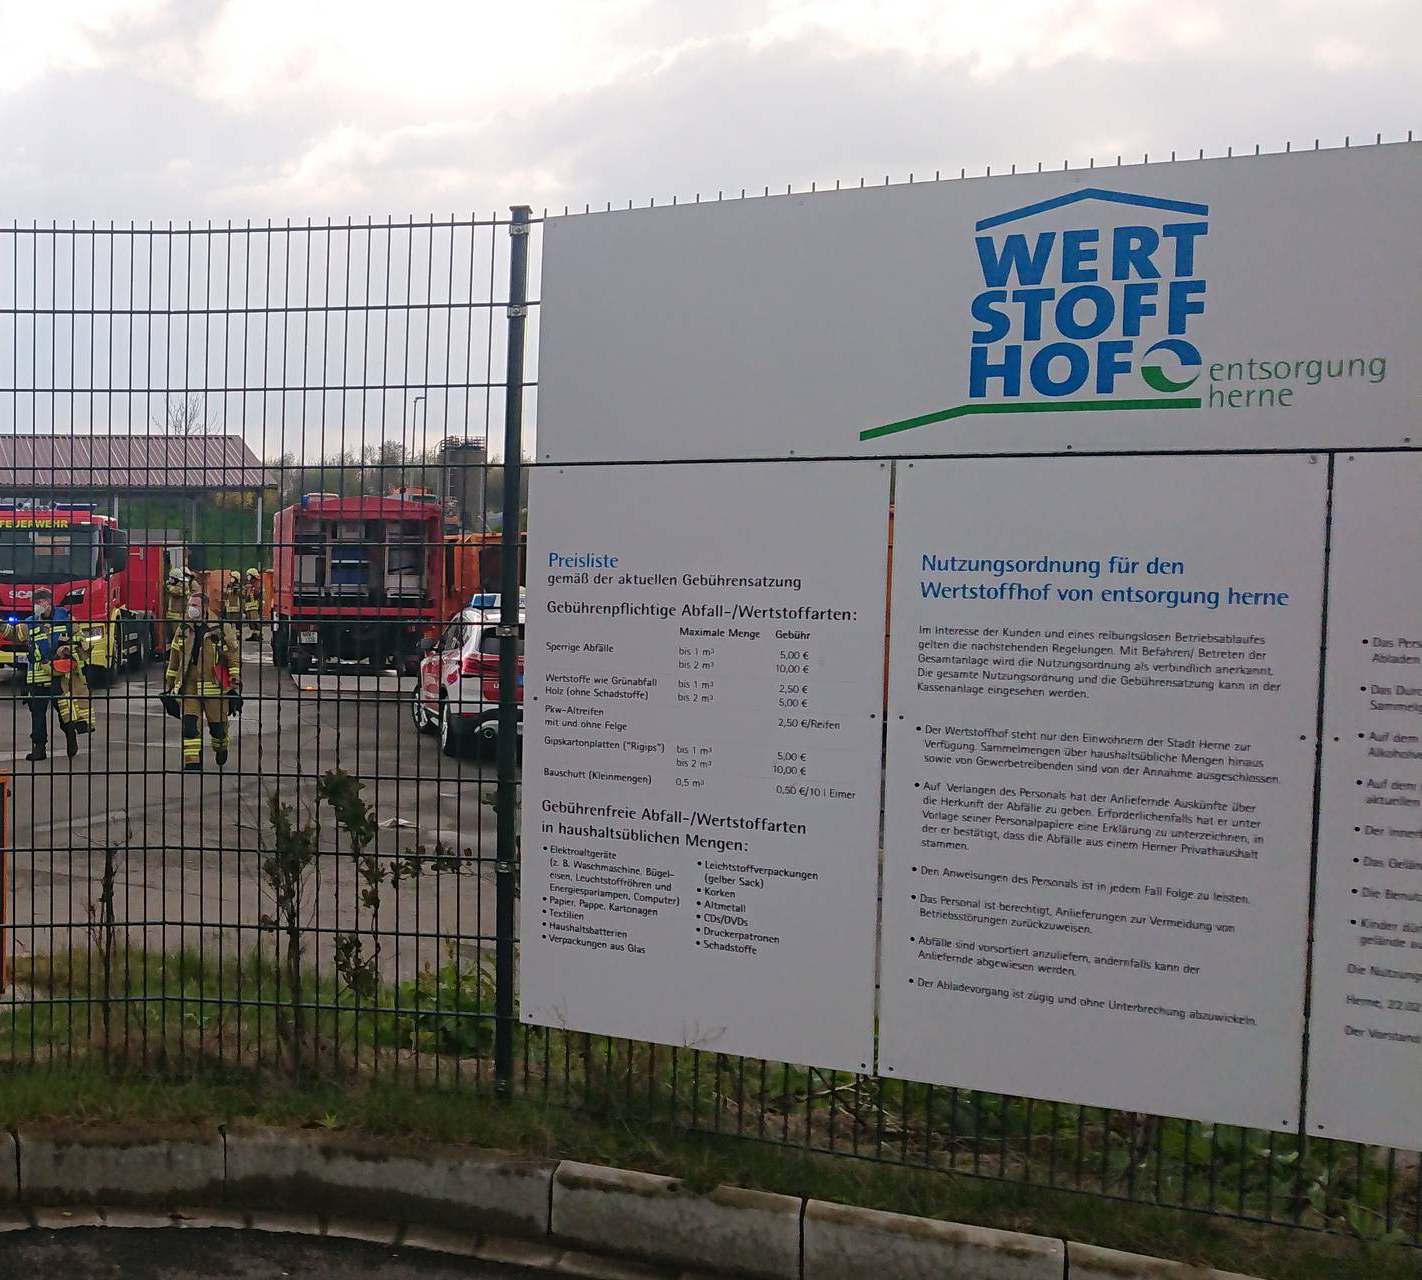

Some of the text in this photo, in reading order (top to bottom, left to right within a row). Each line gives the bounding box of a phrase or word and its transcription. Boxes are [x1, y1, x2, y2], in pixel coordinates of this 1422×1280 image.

[975, 222, 1208, 288] WERT
[971, 280, 1206, 344] STOFF
[969, 340, 1133, 398] HOF
[1209, 357, 1386, 385] entsorgung
[1209, 384, 1294, 408] herne
[549, 552, 619, 568] Preisliste
[922, 554, 1184, 579] Nutzungsordnung für den
[547, 572, 801, 591] gemäß der aktuellen Gebührensatzung
[920, 582, 1289, 610] Wertstoffhof von entsorgung herne
[547, 600, 857, 621] Gebührenpflichtige Abfall-/Wertstoffarten:
[679, 627, 760, 640] Maximale Menge
[775, 630, 811, 640] Gebühr
[919, 625, 931, 634] Im
[982, 627, 999, 636] der
[1002, 627, 1041, 638] Kunden
[1044, 629, 1065, 639] und
[1067, 631, 1095, 640] eines
[1098, 630, 1171, 643] reibungslosen
[1175, 632, 1265, 645] Betriebsablaufes
[546, 641, 614, 653] Sperrige Abfälle
[679, 647, 691, 656] bis
[918, 640, 950, 651] gelten
[952, 640, 968, 650] die
[971, 642, 1048, 652] nachstehenden
[1120, 645, 1138, 655] Mit
[1198, 648, 1245, 659] Betreten
[1248, 650, 1266, 660] der
[780, 650, 809, 661] 5,00 €
[678, 660, 691, 669] bis
[693, 660, 699, 669] 2
[776, 664, 809, 674] 10,00 €
[545, 673, 591, 684] Wertstoffe
[611, 676, 657, 687] Grünabfall
[678, 679, 691, 689] bis
[545, 686, 648, 701] Holz (ohne Schadstoffe)
[779, 684, 808, 694] 2,50 €
[917, 682, 984, 696] Kassenanlage
[987, 687, 1045, 698] eingesehen
[677, 692, 690, 702] bis
[693, 693, 698, 702] 2
[779, 698, 808, 708] 5,00 €
[545, 704, 604, 716] Pkw-Altreifen
[545, 719, 627, 733] mit und ohne Felge
[778, 718, 840, 730] 2,50 €/Reifen
[544, 736, 620, 749] Gipskartonplatten
[925, 724, 942, 735] Der
[945, 726, 1009, 738] Wertstoffhof
[1011, 731, 1037, 740] steht
[1040, 733, 1057, 741] nur
[1060, 732, 1079, 742] den
[1147, 737, 1164, 747] der
[1167, 737, 1195, 749] Stadt
[1234, 743, 1251, 752] zur
[676, 745, 689, 754] bis
[777, 751, 806, 762] 5,00 €
[676, 758, 689, 767] bis
[691, 759, 697, 768] 2
[772, 765, 806, 776] 10,00 €
[544, 767, 652, 785] Bauschutt (Kleinmengen)
[675, 777, 690, 787] 0,5
[776, 785, 797, 795] 0,50
[799, 786, 821, 797] €/10
[829, 788, 856, 799] Eimer
[542, 799, 806, 834] Gebührenfreie Abfall-/Wertstoffarten
[542, 821, 748, 853] in haushaltsüblichen Mengen:
[921, 839, 969, 850] stammen.
[550, 845, 617, 860] Elektroaltgeräte
[646, 867, 675, 880] Bügel-
[705, 860, 818, 881] Leichtstoffverpackungen
[549, 872, 672, 892] eisen, Leuchtstoffröhren und
[704, 873, 764, 889] (gelber Sack)
[633, 892, 680, 907] Computer)
[704, 887, 736, 898] Korken
[549, 908, 584, 920] Textilien
[609, 902, 658, 917] Kartonagen
[704, 900, 746, 913] Altmetall
[703, 913, 748, 927] CDs/DVDs
[919, 907, 1008, 927] Betriebsstörungen
[549, 922, 628, 938] Haushaltsbatterien
[703, 926, 780, 944] Druckerpatronen
[548, 934, 646, 954] Verpackungen aus Glas
[703, 939, 757, 955] Schadstoffe
[918, 949, 974, 965] Anliefernde
[976, 957, 1034, 971] abgewiesen
